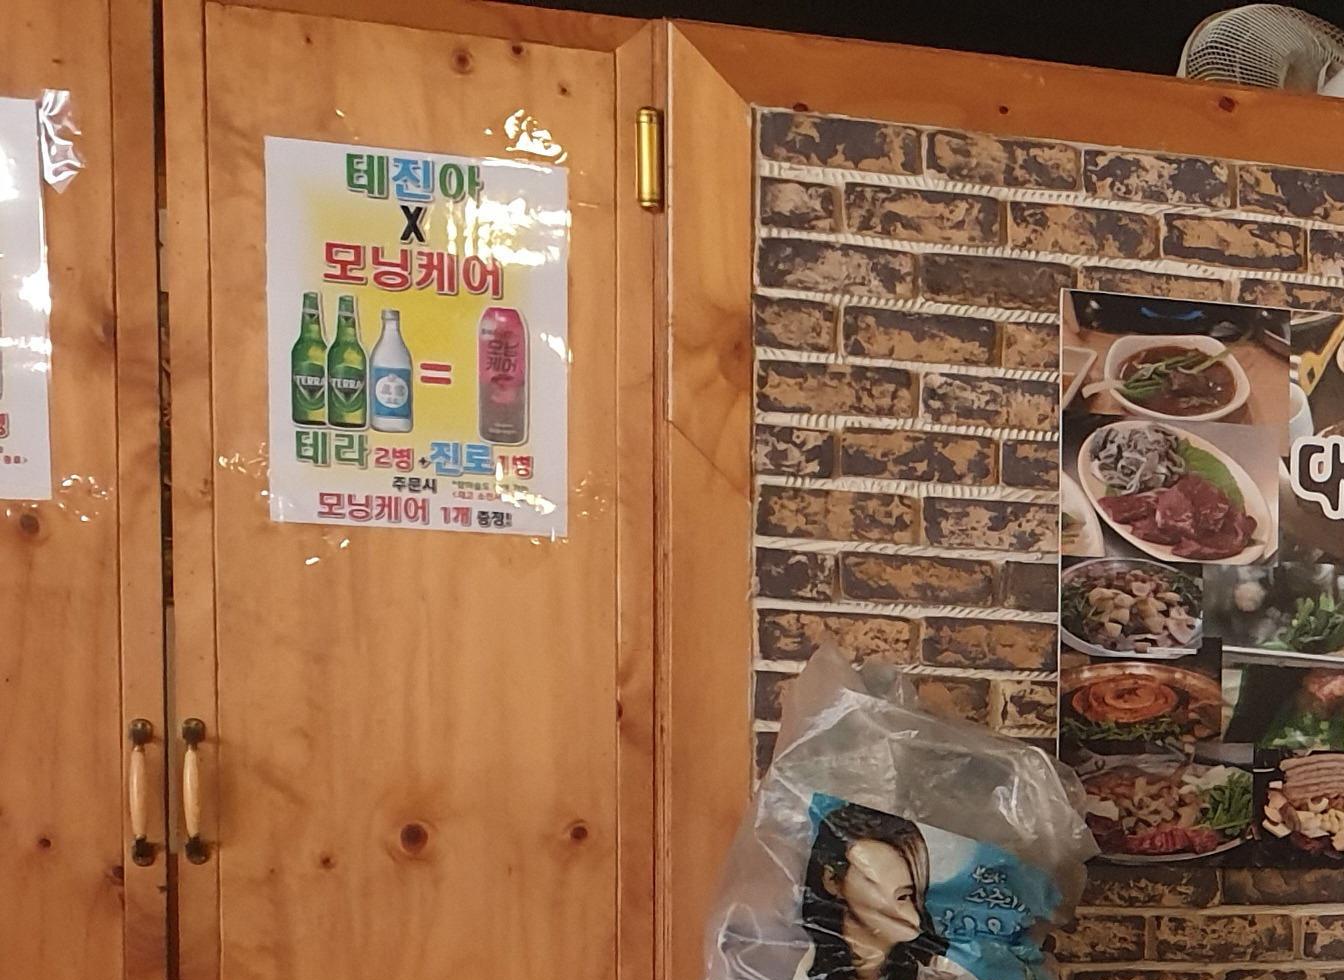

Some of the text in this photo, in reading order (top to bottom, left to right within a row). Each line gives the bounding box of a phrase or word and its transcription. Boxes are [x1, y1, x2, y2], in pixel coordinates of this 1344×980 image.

[346, 153, 484, 201] 테진아
[323, 242, 503, 299] 모닝케어
[295, 430, 534, 479] 테라 2병 진로 1병
[392, 476, 437, 493] 주문시
[317, 491, 431, 525] 모닝케어
[440, 506, 473, 528] 1개
